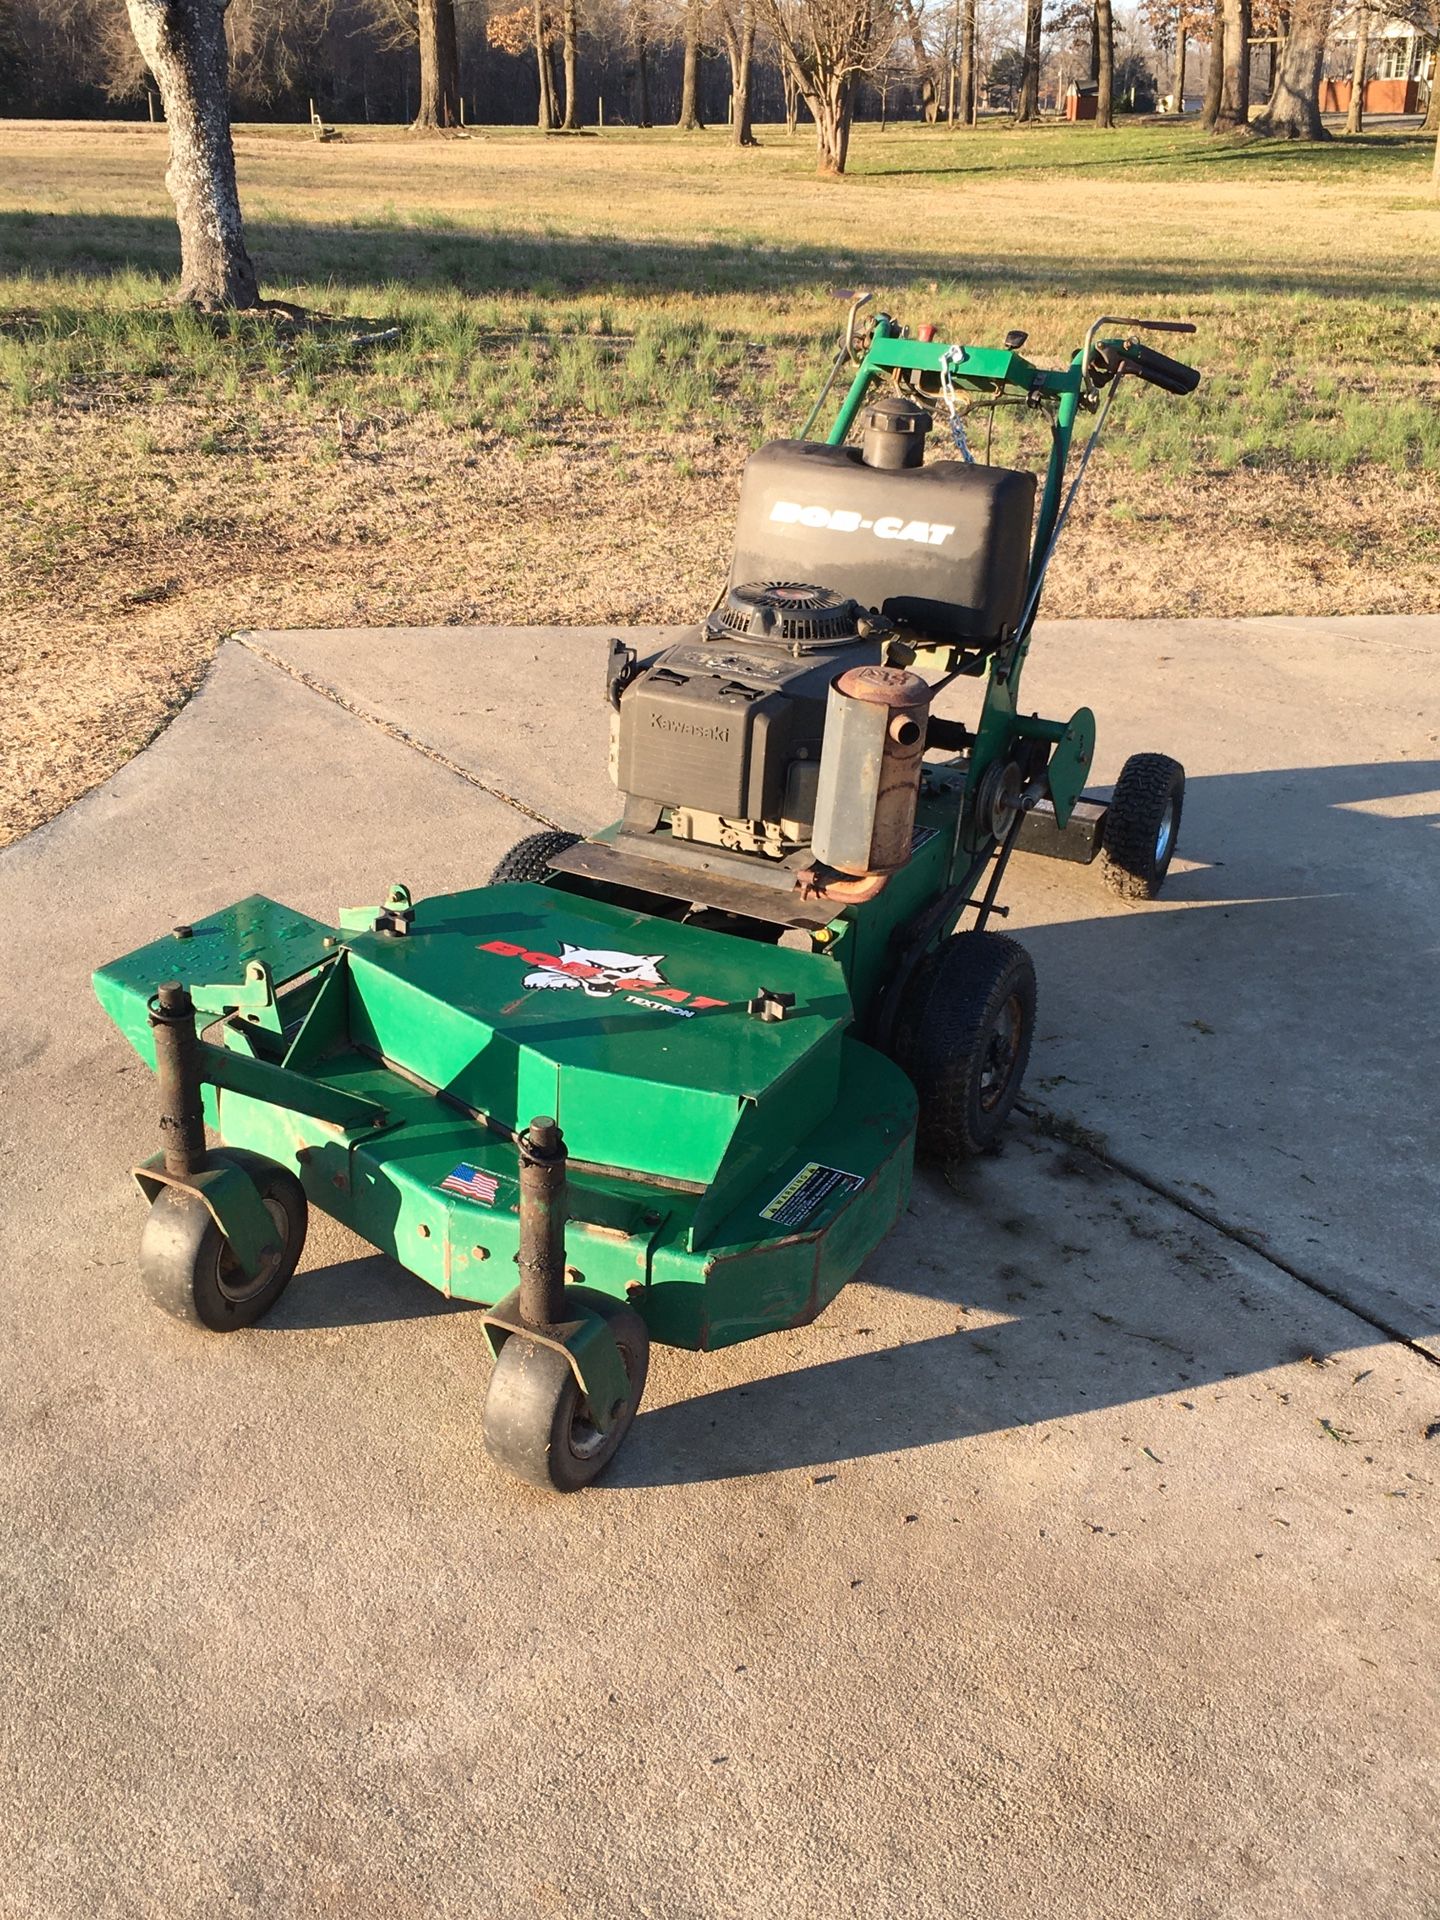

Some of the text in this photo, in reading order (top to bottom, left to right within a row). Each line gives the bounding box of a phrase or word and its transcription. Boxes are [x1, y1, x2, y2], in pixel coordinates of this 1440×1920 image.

[769, 501, 955, 545] BOB-CAT
[650, 713, 730, 743] Kawasaki
[624, 995, 697, 1018] TEXTRON
[775, 1174, 808, 1206] WARNING
